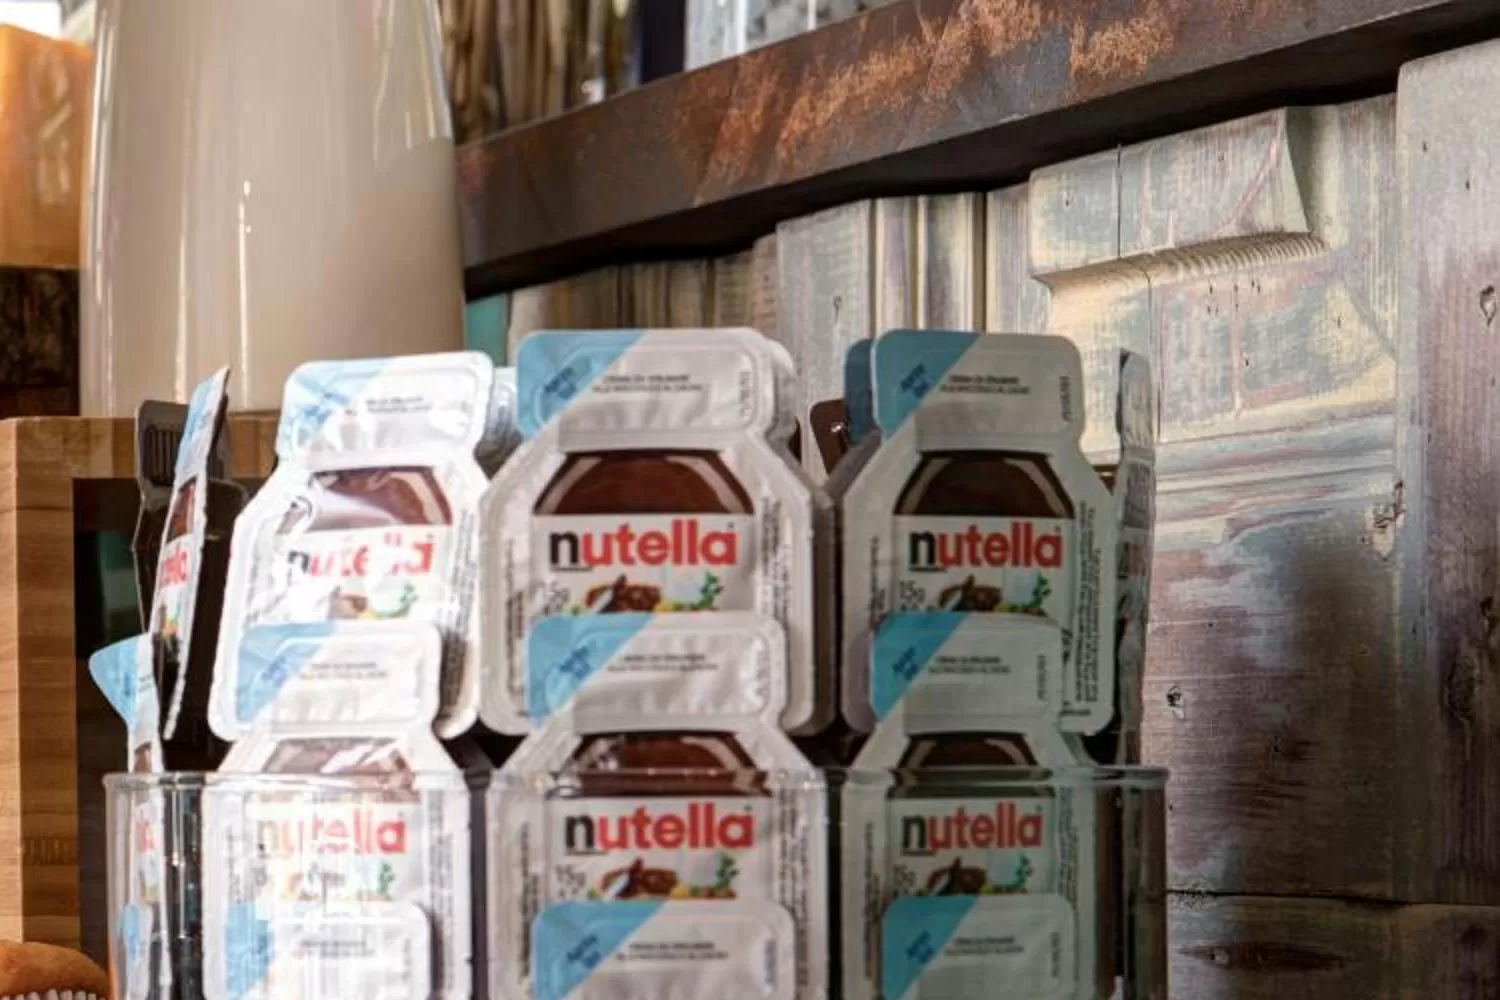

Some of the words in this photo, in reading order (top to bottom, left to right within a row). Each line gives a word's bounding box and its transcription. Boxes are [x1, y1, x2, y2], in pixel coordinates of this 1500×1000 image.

[550, 519, 740, 567] nutella
[909, 521, 1063, 568] nutella
[565, 803, 755, 850] nutella
[901, 802, 1043, 850] nutella
